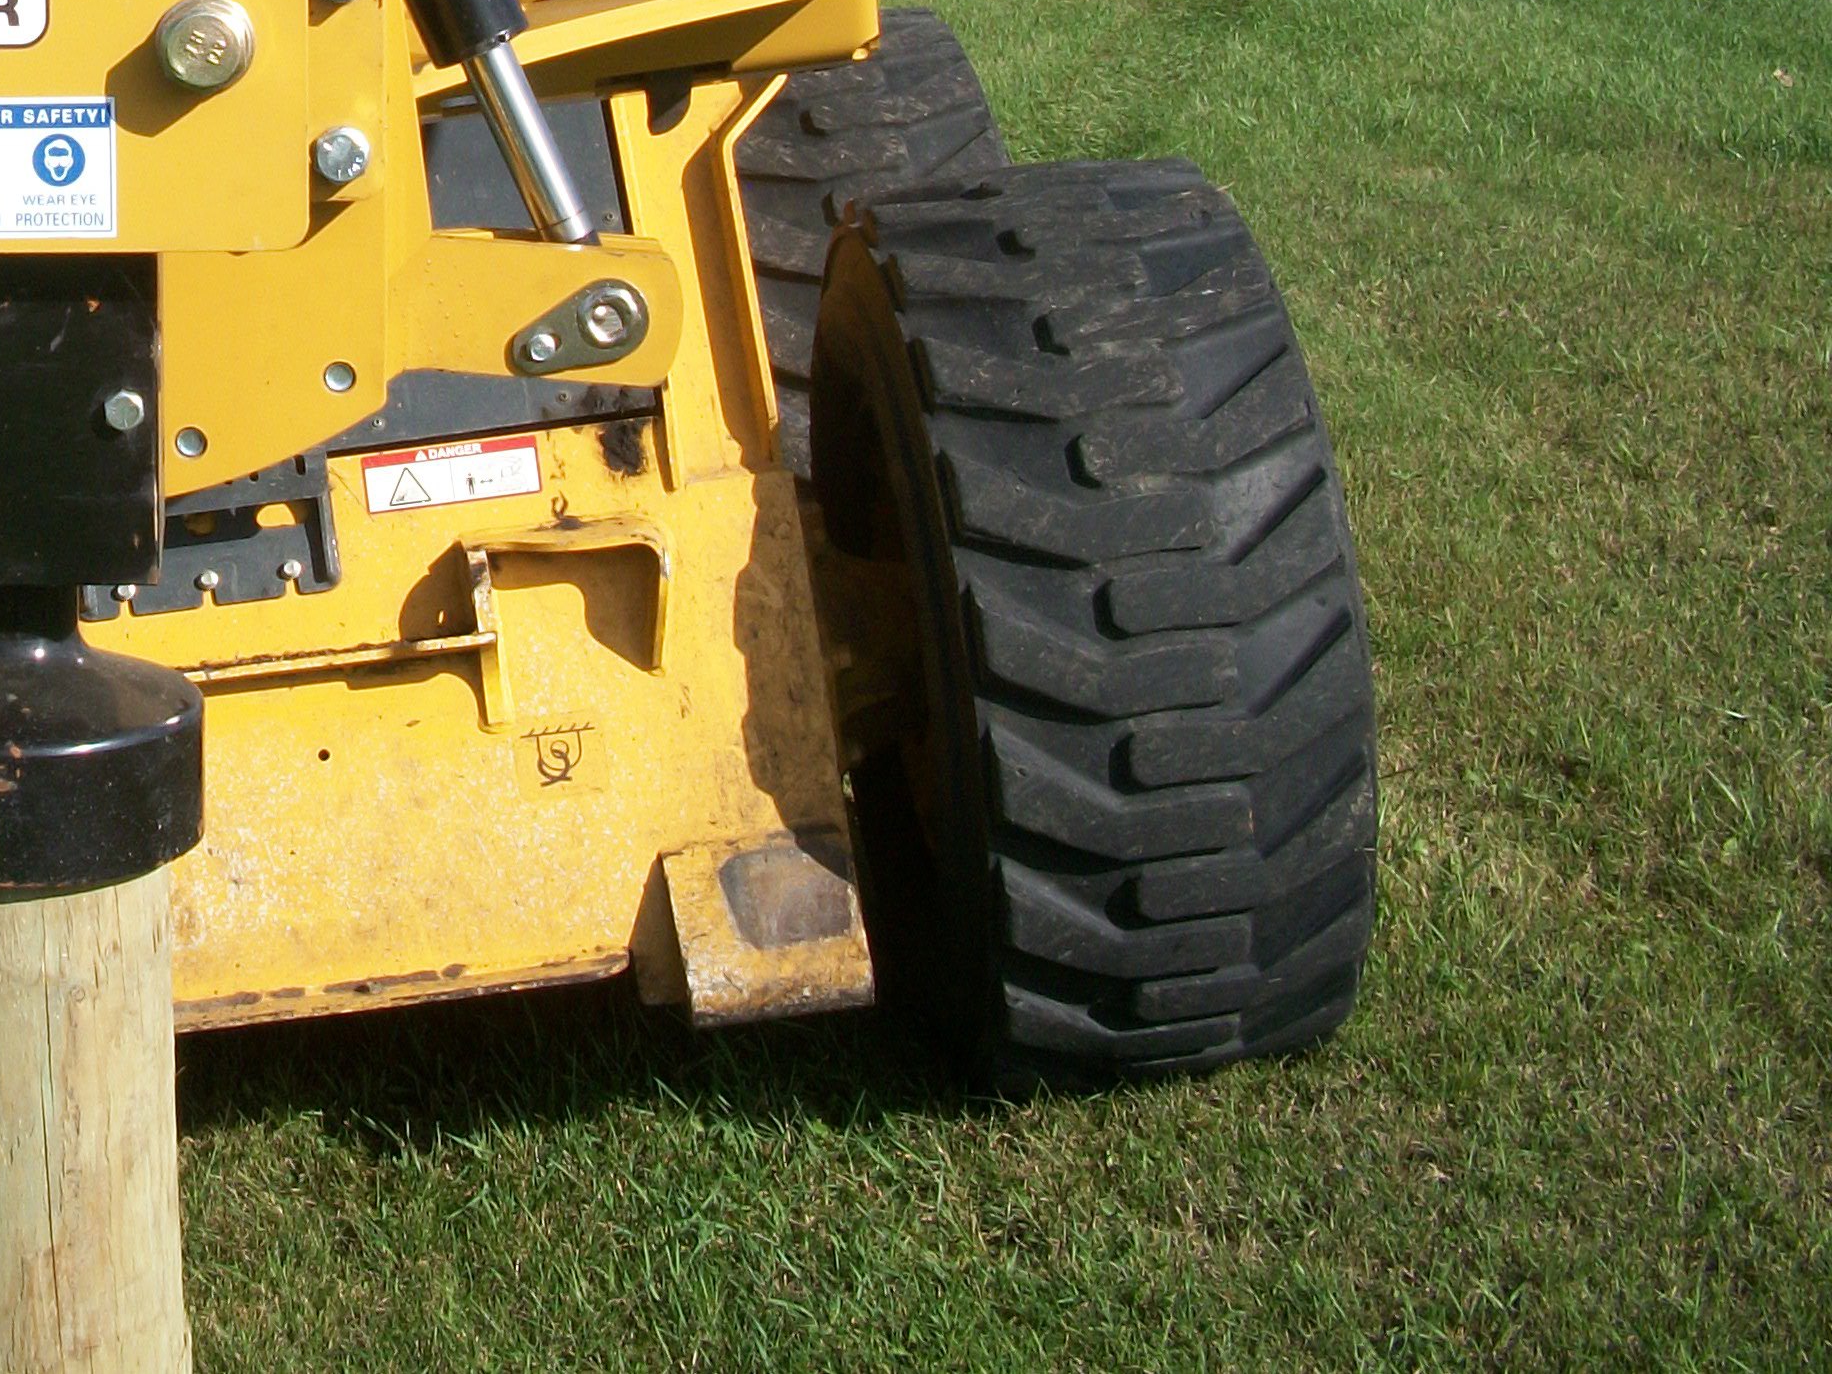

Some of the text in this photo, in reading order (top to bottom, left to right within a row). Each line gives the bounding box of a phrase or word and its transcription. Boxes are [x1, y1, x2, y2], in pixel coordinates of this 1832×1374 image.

[22, 107, 106, 124] SAFETY!
[22, 193, 97, 206] WEAR EYE
[15, 211, 104, 226] PROTECTION
[427, 443, 483, 460] DANGER
